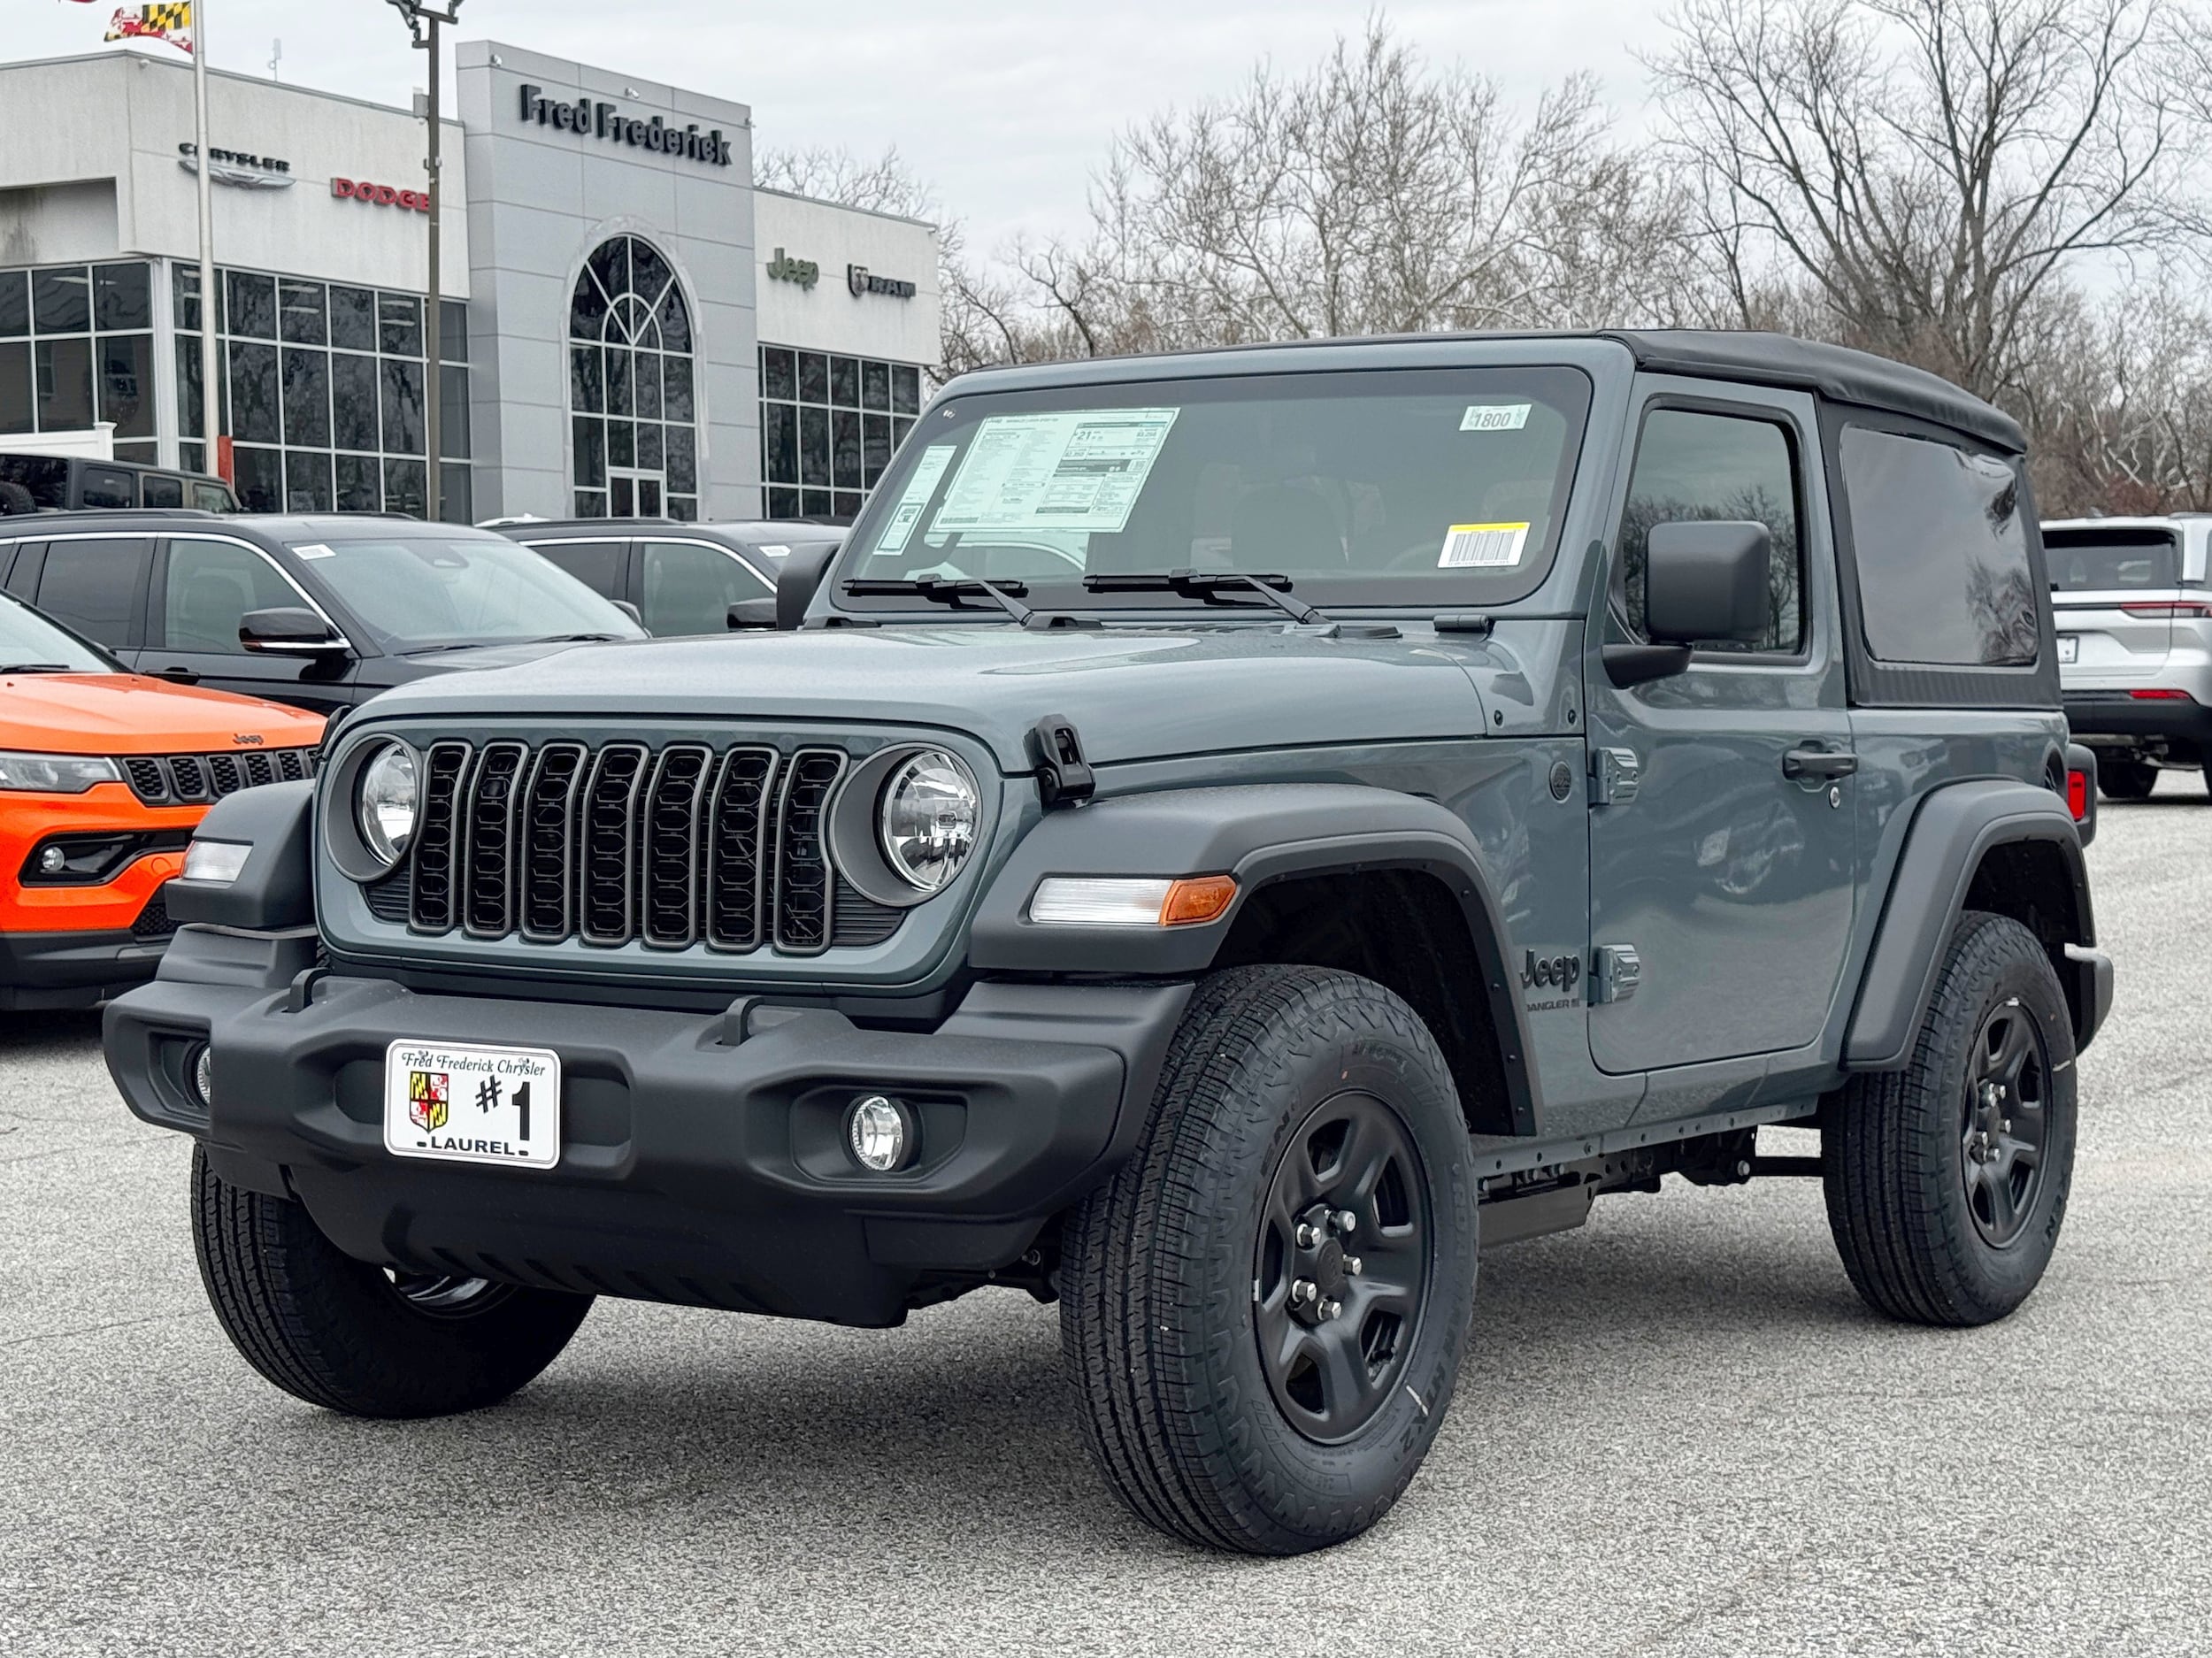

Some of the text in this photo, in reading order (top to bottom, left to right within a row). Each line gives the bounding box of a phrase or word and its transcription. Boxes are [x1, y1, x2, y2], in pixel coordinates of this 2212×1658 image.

[520, 84, 732, 165] Fred Frederick
[179, 142, 290, 172] CRYSLER
[766, 248, 818, 291] Jeep
[868, 276, 916, 297] RAM
[1474, 412, 1511, 427] 1800
[1519, 948, 1579, 993] Jeep
[402, 1050, 545, 1076] Fred Frederick Chrysler
[431, 1136, 515, 1155] LAUREL
